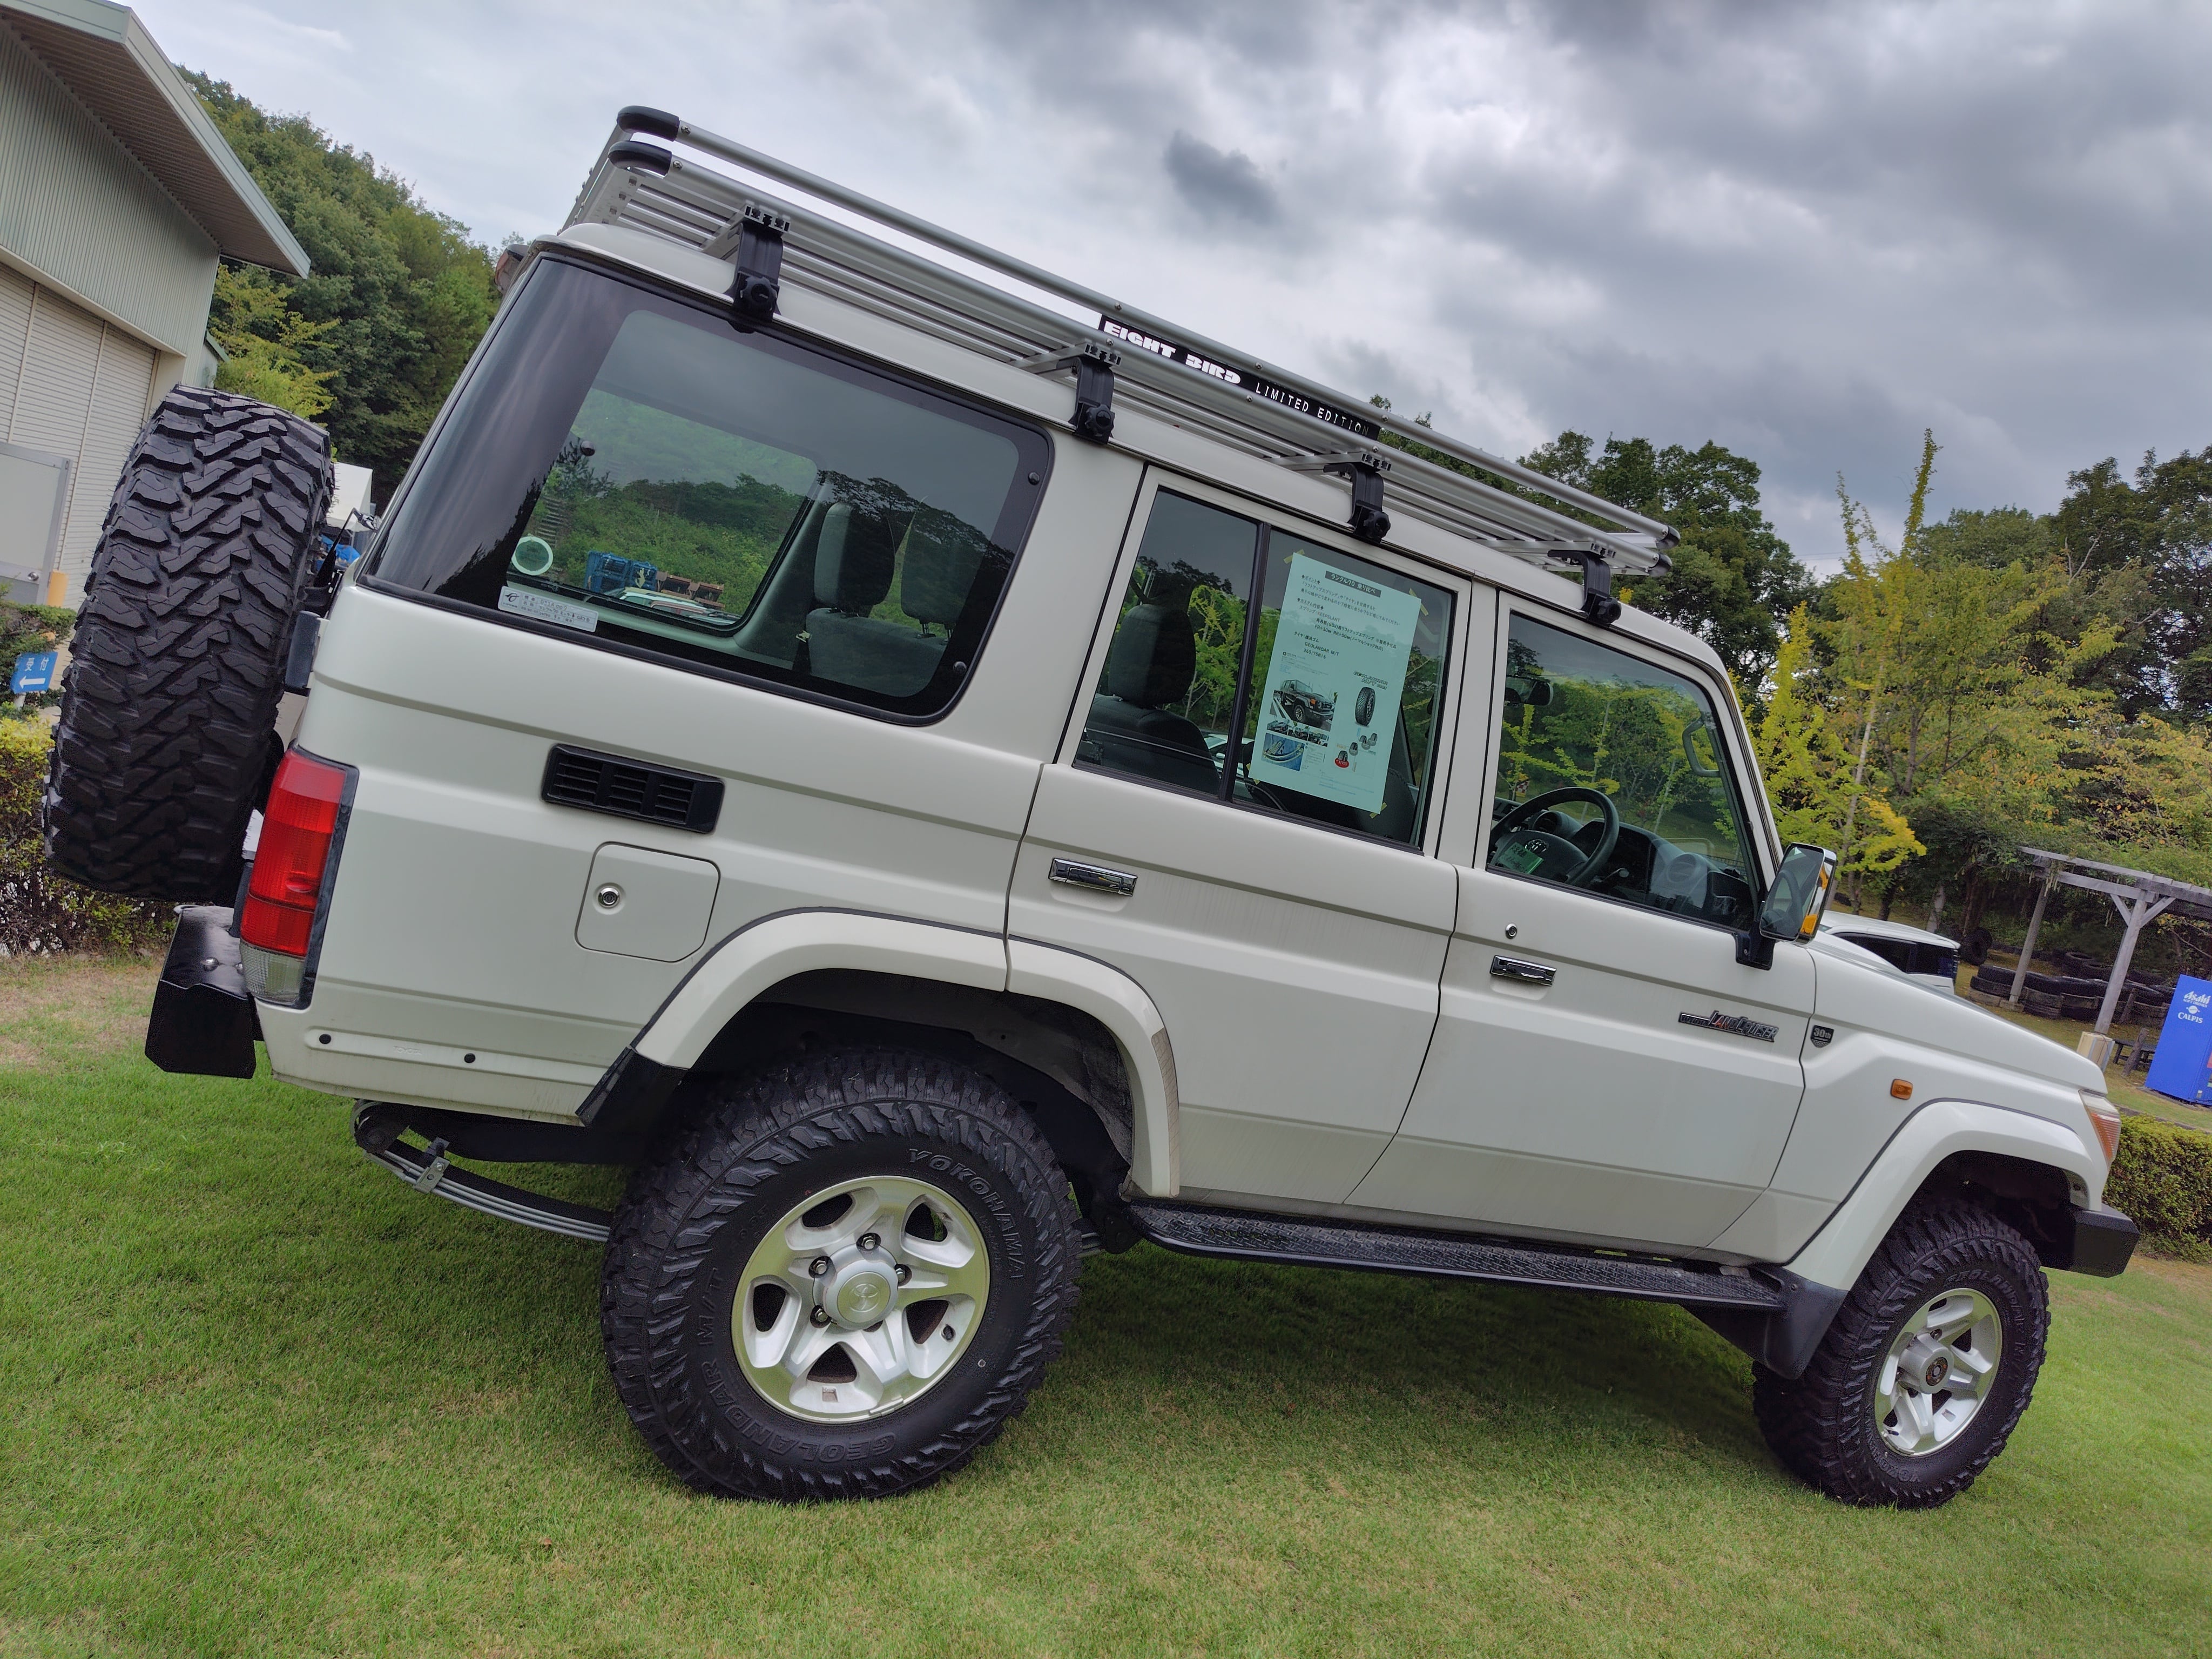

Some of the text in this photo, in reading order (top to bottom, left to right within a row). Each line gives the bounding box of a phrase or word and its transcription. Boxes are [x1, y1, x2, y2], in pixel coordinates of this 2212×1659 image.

[1103, 320, 1370, 436] EIGHT BIRD LIMITED EDITION
[25, 657, 49, 672] 受付
[2184, 991, 2211, 1004] Asahi
[2177, 1011, 2203, 1023] CALPIS
[1813, 1028, 1832, 1039] 30th
[909, 1148, 1026, 1278] YOKOHAMA
[702, 1358, 896, 1463] GEOLANDAR
